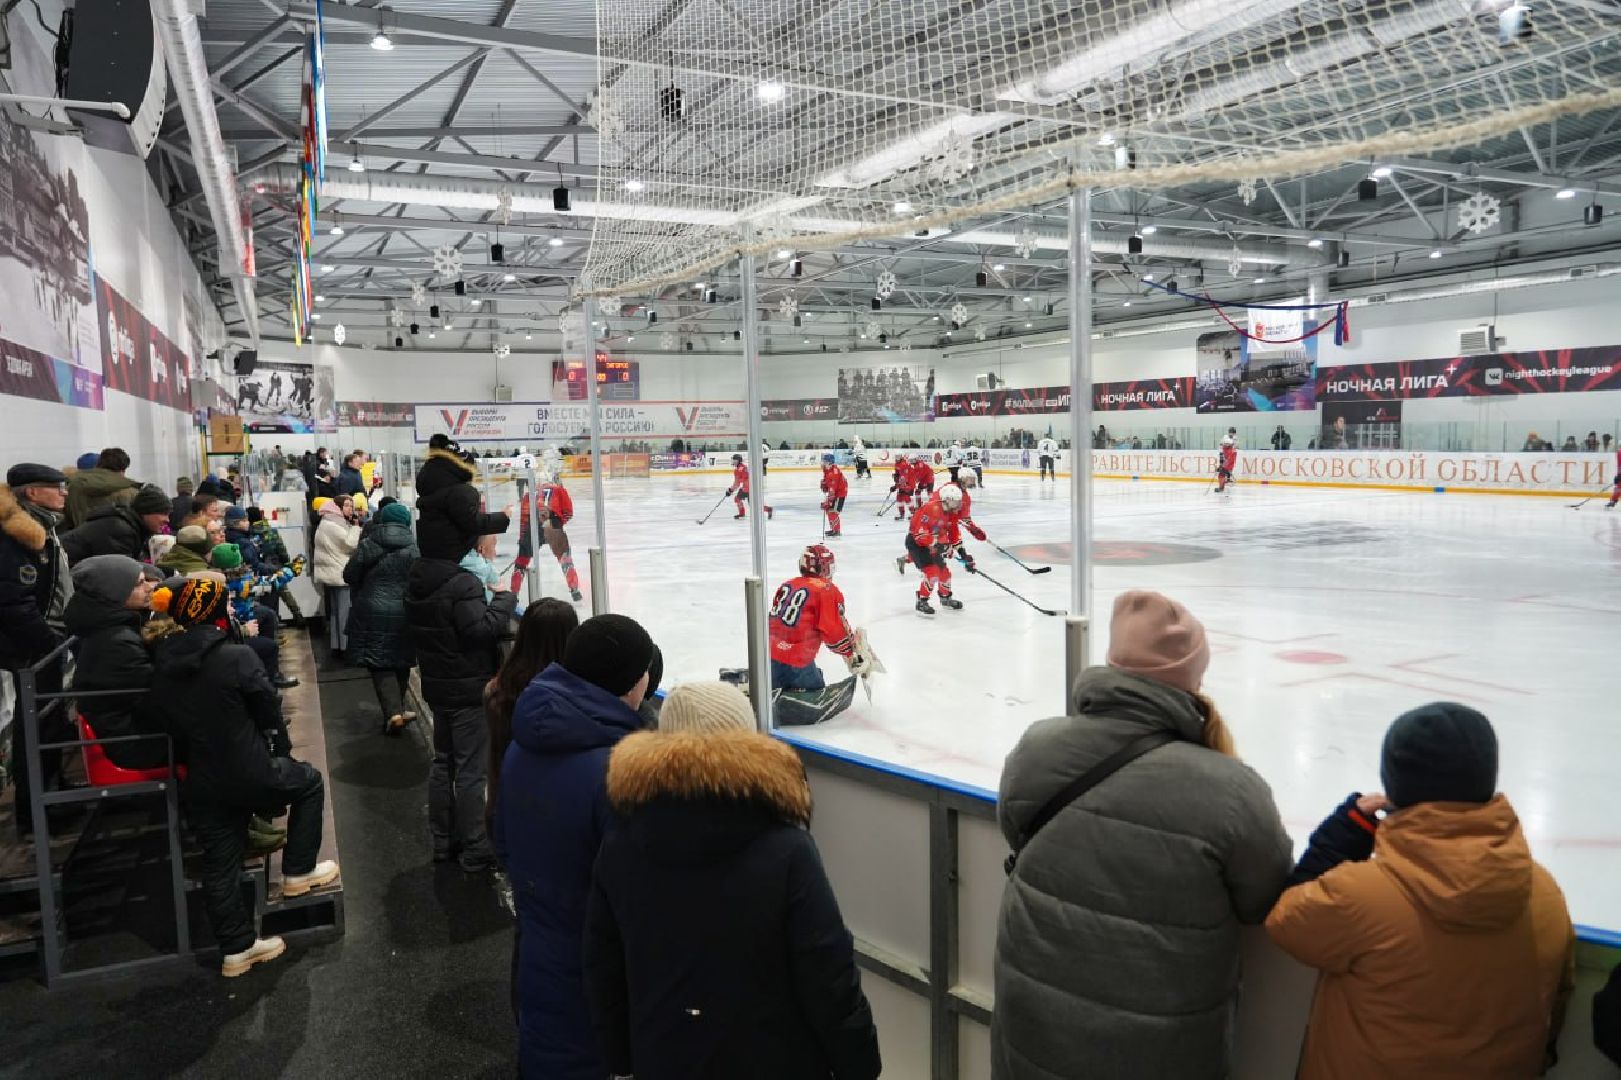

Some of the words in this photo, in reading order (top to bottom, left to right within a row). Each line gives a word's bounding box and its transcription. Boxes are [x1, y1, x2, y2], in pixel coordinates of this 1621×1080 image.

[1504, 366, 1613, 381] nighthockeyleague
[1326, 377, 1395, 393] НОЧНАЯ
[1400, 375, 1449, 390] ЛИГА
[1100, 392, 1144, 404] НОЧНАЯ
[1146, 390, 1176, 402] ЛИГА
[537, 407, 580, 420] ВМЕСТЕ
[606, 407, 635, 420] СИЛА
[524, 459, 531, 469] 2
[1091, 453, 1220, 474] РАВИТЕЛЬСТВ
[1241, 453, 1426, 480] МОСКОВСКОЙ
[1437, 458, 1609, 485] ОБЛАСТИ
